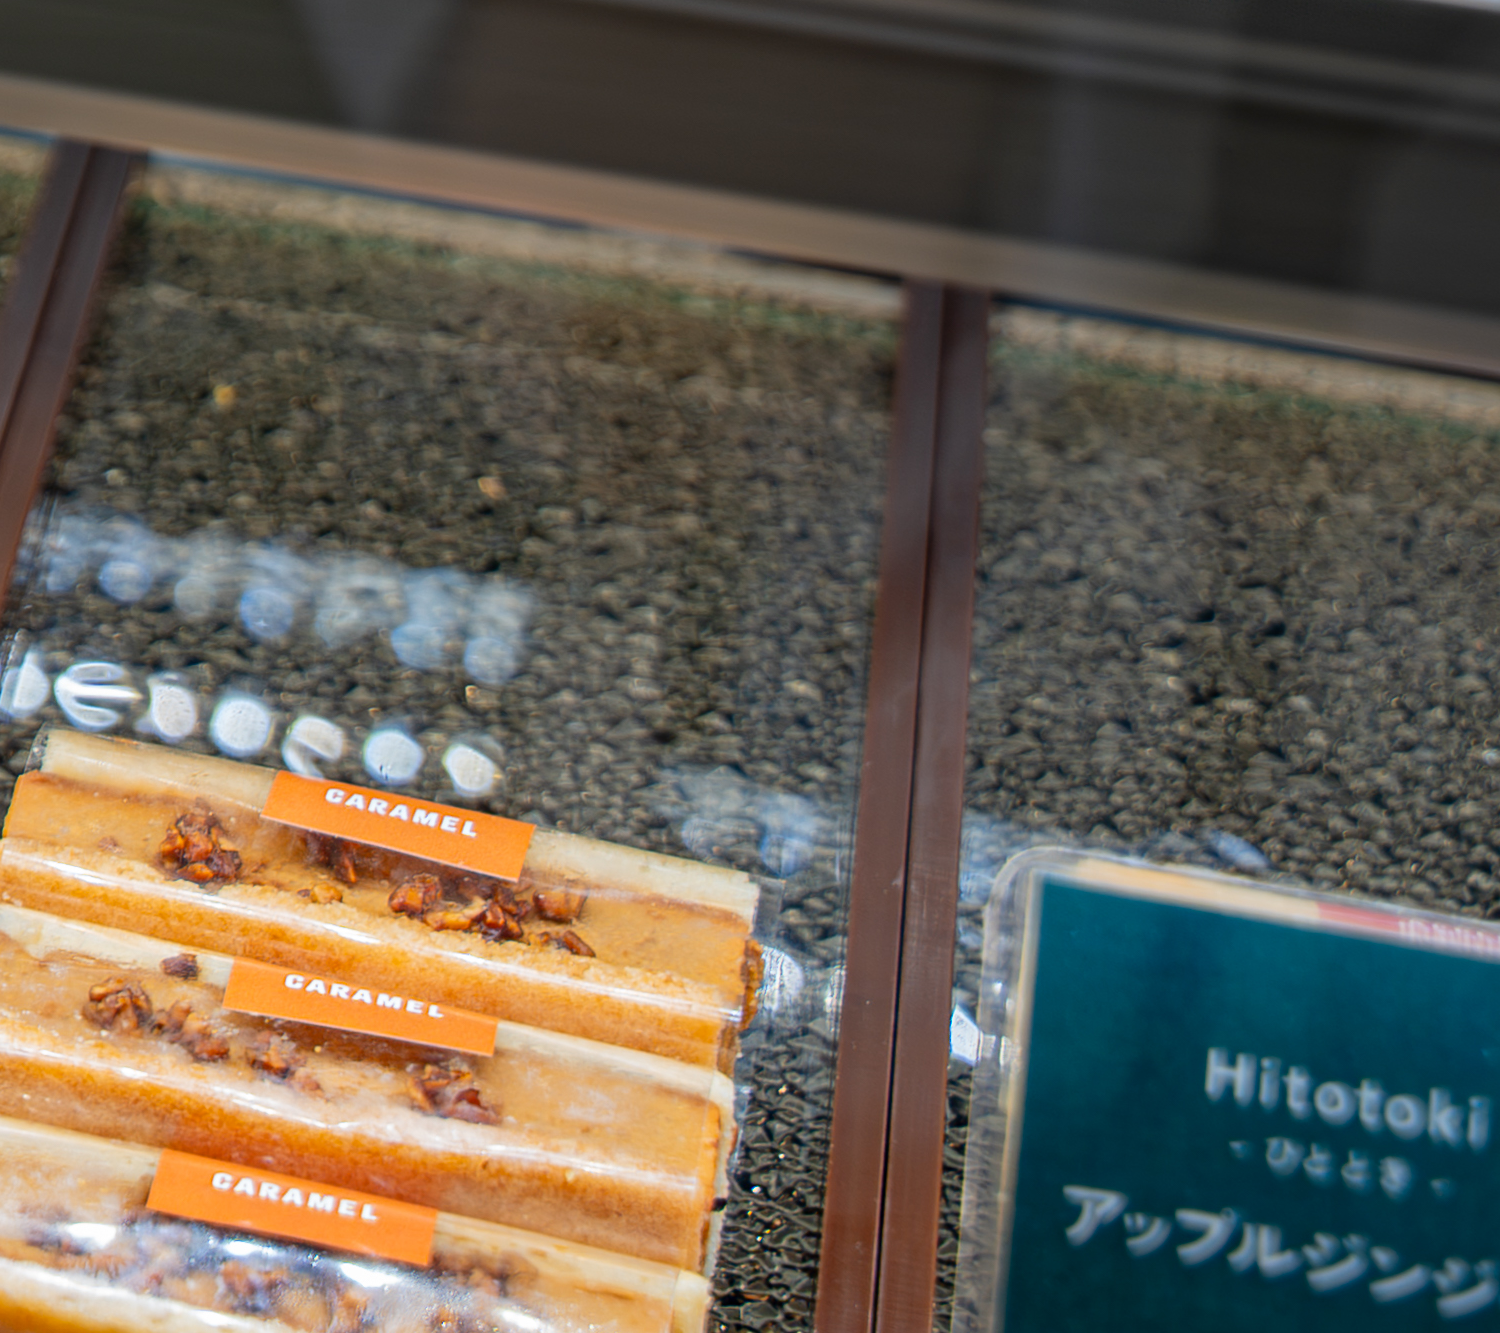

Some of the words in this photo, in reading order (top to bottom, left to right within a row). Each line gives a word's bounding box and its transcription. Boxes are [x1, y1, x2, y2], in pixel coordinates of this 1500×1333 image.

[325, 788, 478, 838] CARAMEL
[284, 974, 444, 1019] CARAMEL
[1204, 1046, 1490, 1152] Hitotoki
[211, 1172, 379, 1222] CARAMEL
